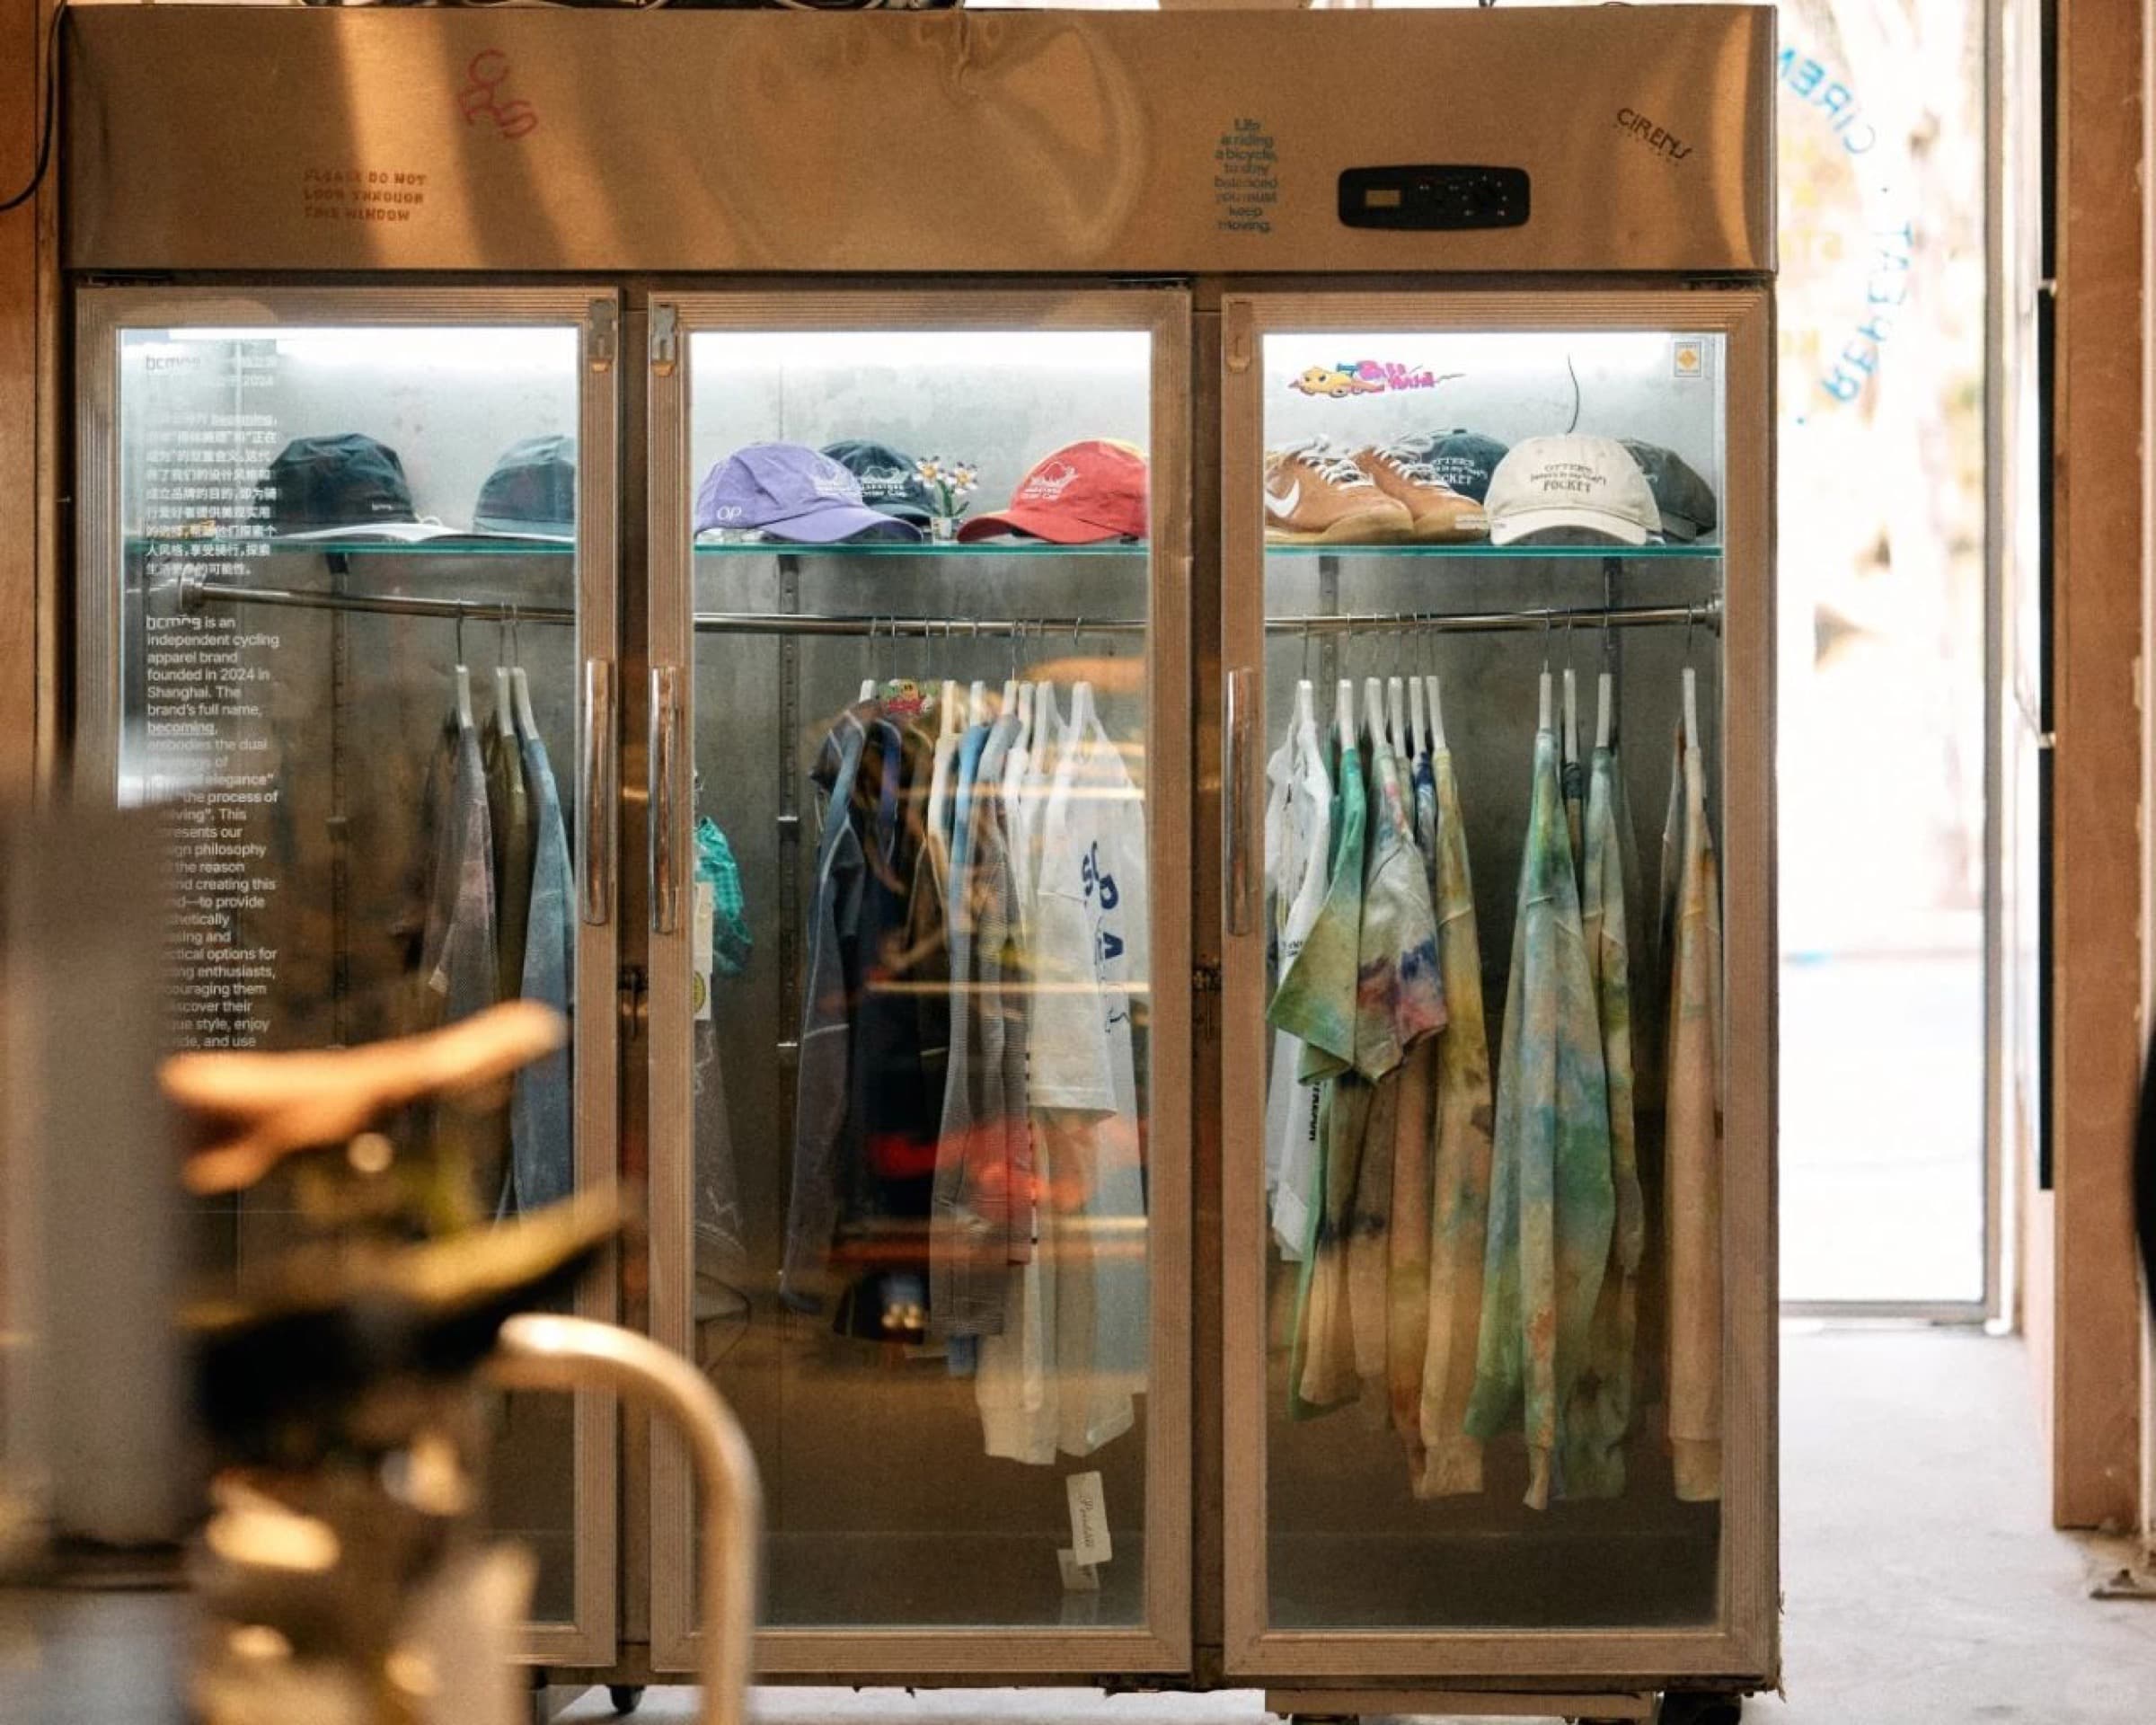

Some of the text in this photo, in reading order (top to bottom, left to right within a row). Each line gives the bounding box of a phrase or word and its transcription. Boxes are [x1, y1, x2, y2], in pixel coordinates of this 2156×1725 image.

[368, 171, 389, 184] DO
[393, 172, 427, 186] NOT
[346, 208, 411, 221] WINDOW
[204, 615, 216, 628] is
[218, 618, 236, 629] an
[147, 633, 280, 650] independent cycling
[147, 651, 238, 666] apparel brand
[147, 668, 270, 681] founded in 2024 in
[147, 685, 242, 701] Shanghai. The
[147, 702, 262, 718] brand's full name,
[147, 721, 217, 736] becoming,
[215, 739, 236, 751] the
[238, 739, 268, 750] dual
[215, 756, 229, 768] of
[207, 792, 261, 806] process
[263, 791, 278, 803] of
[218, 809, 247, 821] This
[220, 827, 243, 839] our
[194, 843, 267, 859] philosophy
[199, 862, 245, 874] reason
[195, 879, 250, 894] creating
[252, 879, 276, 892] this
[215, 896, 266, 911] provide
[206, 931, 231, 943] and
[207, 949, 257, 963] options
[259, 948, 278, 961] for
[198, 965, 276, 980] enthusiasts,
[164, 982, 267, 998] ouraging them
[223, 1000, 252, 1013] their
[196, 1017, 231, 1032] style,
[234, 1017, 270, 1033] enjoy
[203, 1035, 230, 1048] and
[232, 1035, 257, 1048] use
